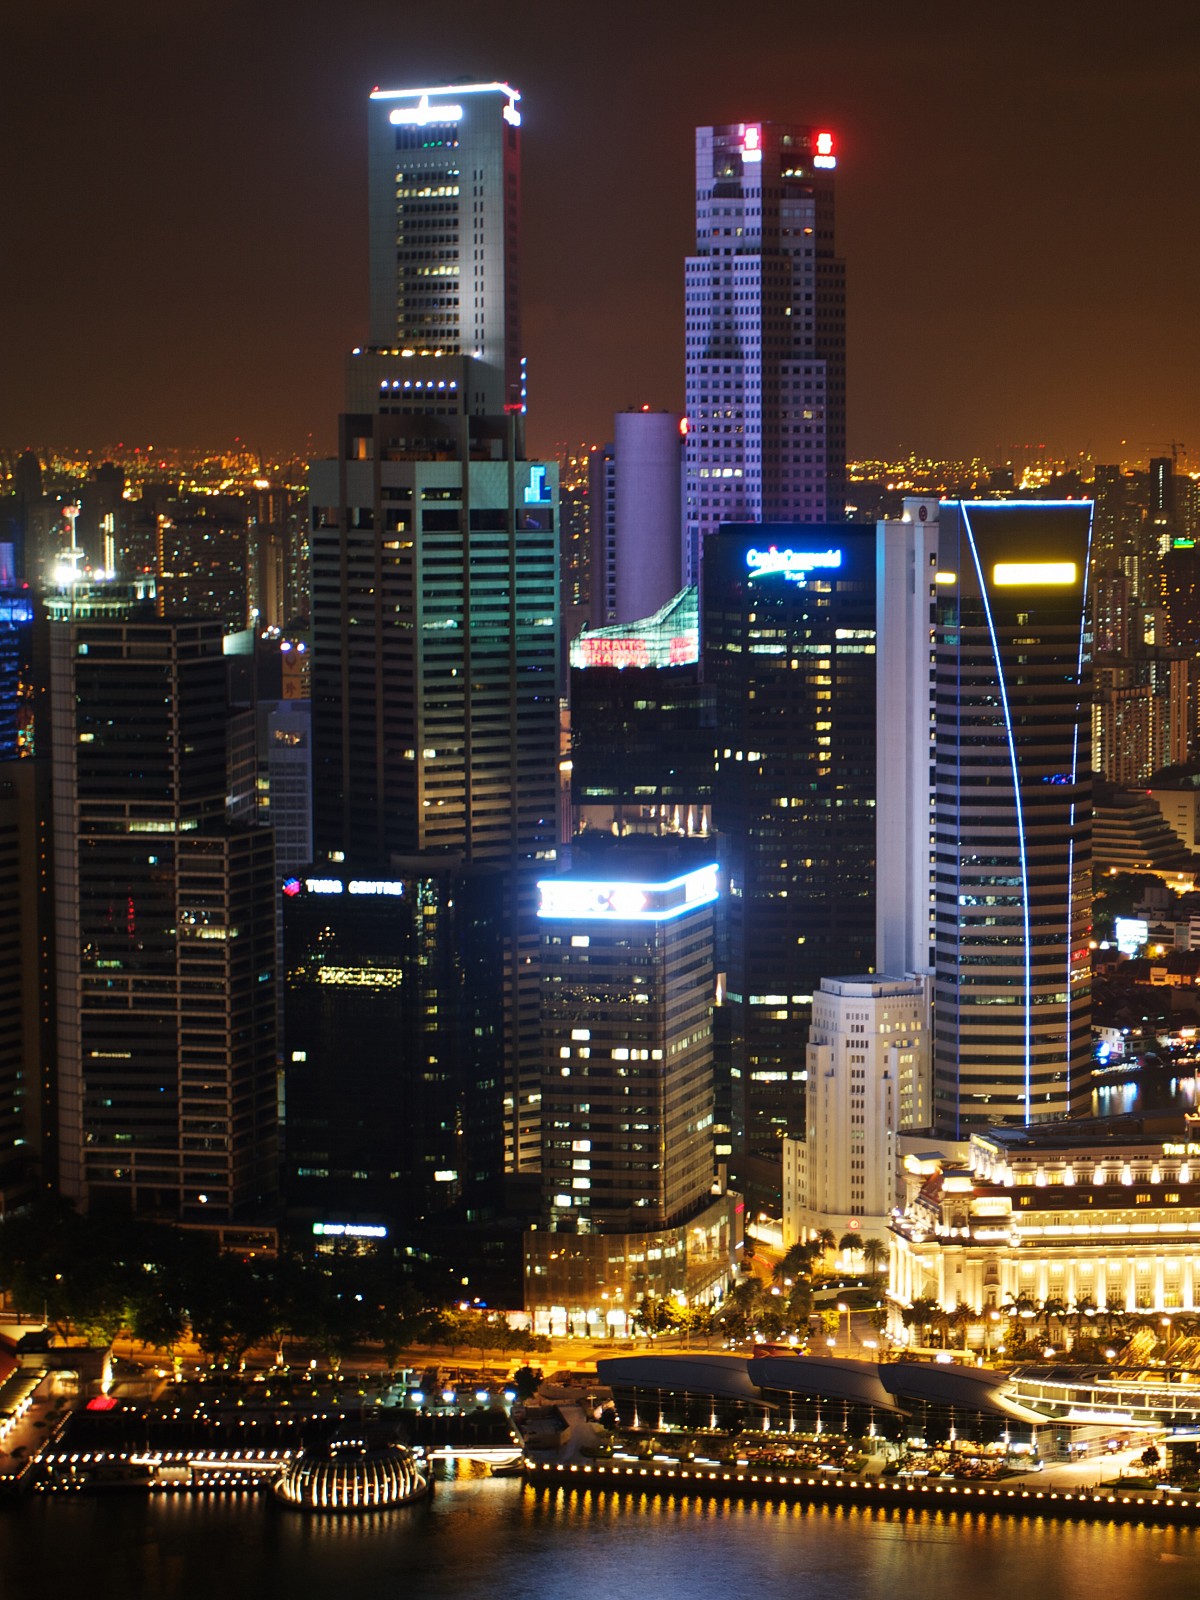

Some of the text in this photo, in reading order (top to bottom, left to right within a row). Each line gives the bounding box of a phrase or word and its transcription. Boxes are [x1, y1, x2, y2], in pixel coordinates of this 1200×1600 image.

[581, 639, 646, 651] STRAITS
[348, 880, 403, 896] CENTRE
[1162, 1143, 1186, 1154] THE
